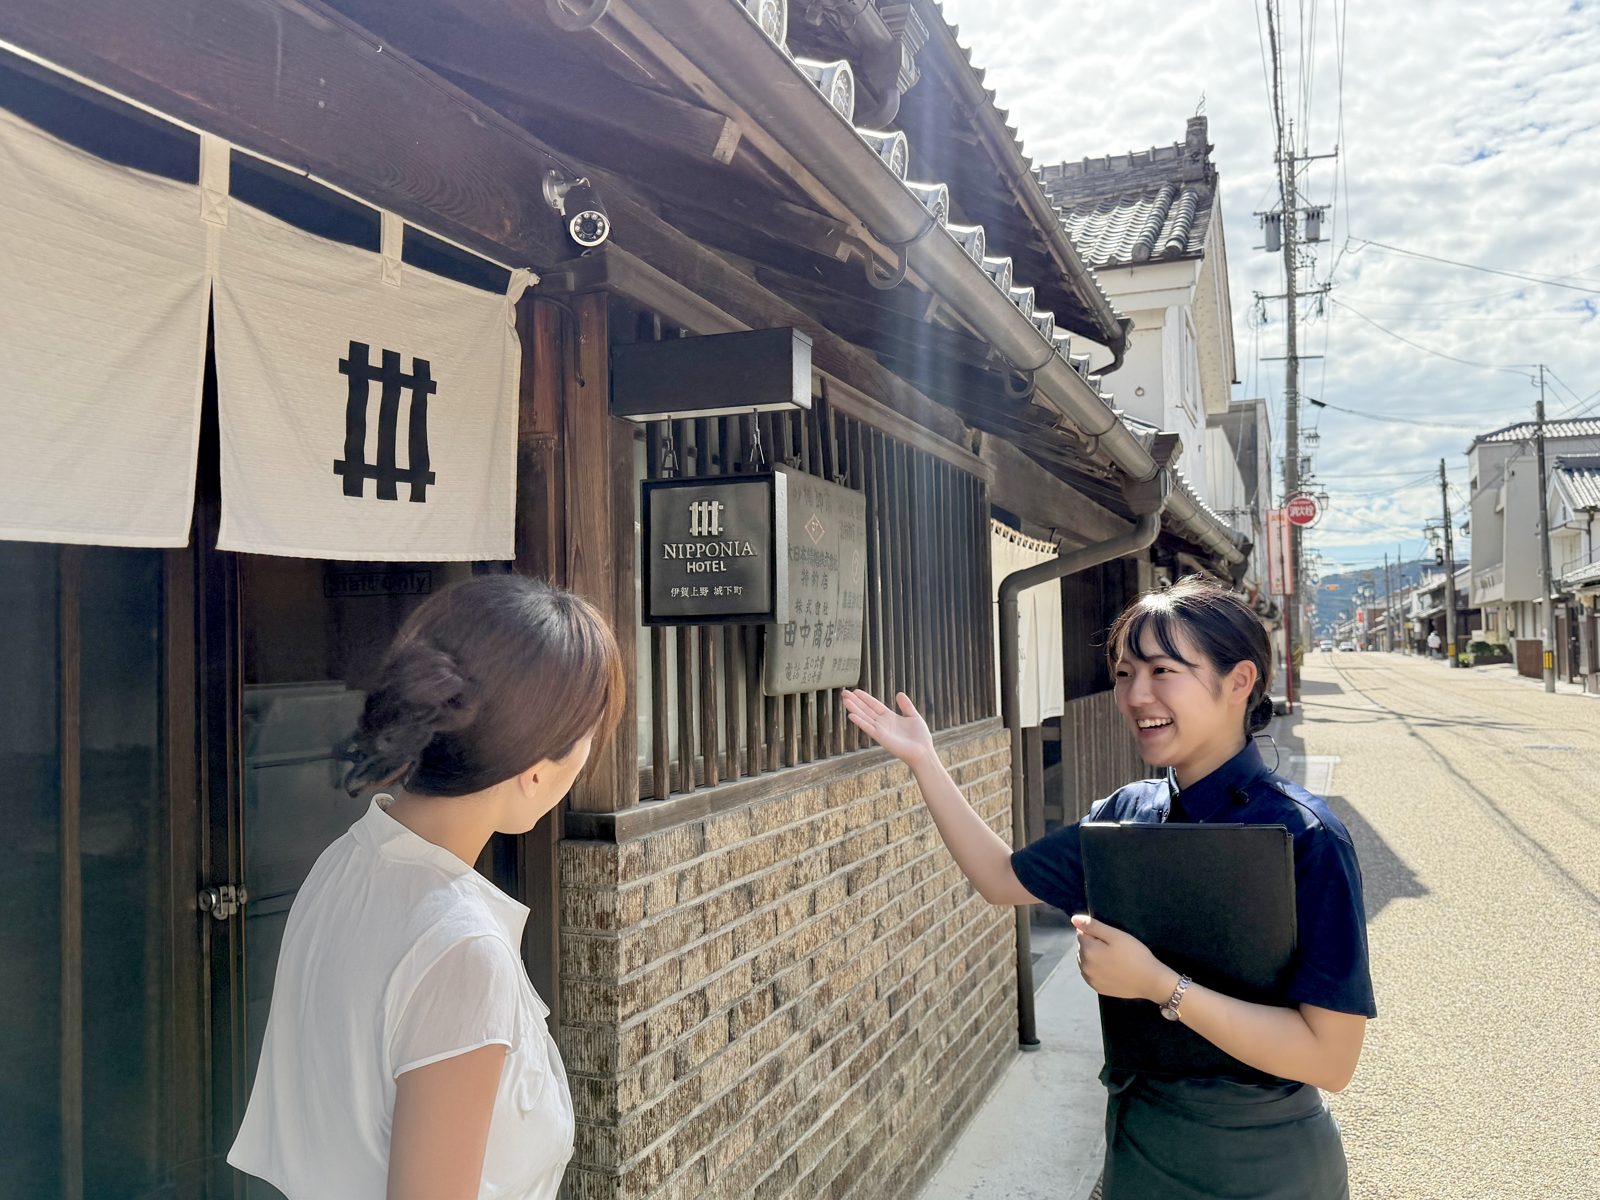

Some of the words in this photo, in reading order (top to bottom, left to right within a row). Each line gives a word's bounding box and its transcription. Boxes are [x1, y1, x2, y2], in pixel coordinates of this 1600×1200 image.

[663, 541, 756, 560] NIPPONIA
[686, 560, 727, 574] HOTEL
[383, 572, 426, 593] Only
[670, 586, 709, 598] 伊賀上野
[713, 585, 744, 597] 城下町
[784, 617, 835, 649] 田中商店
